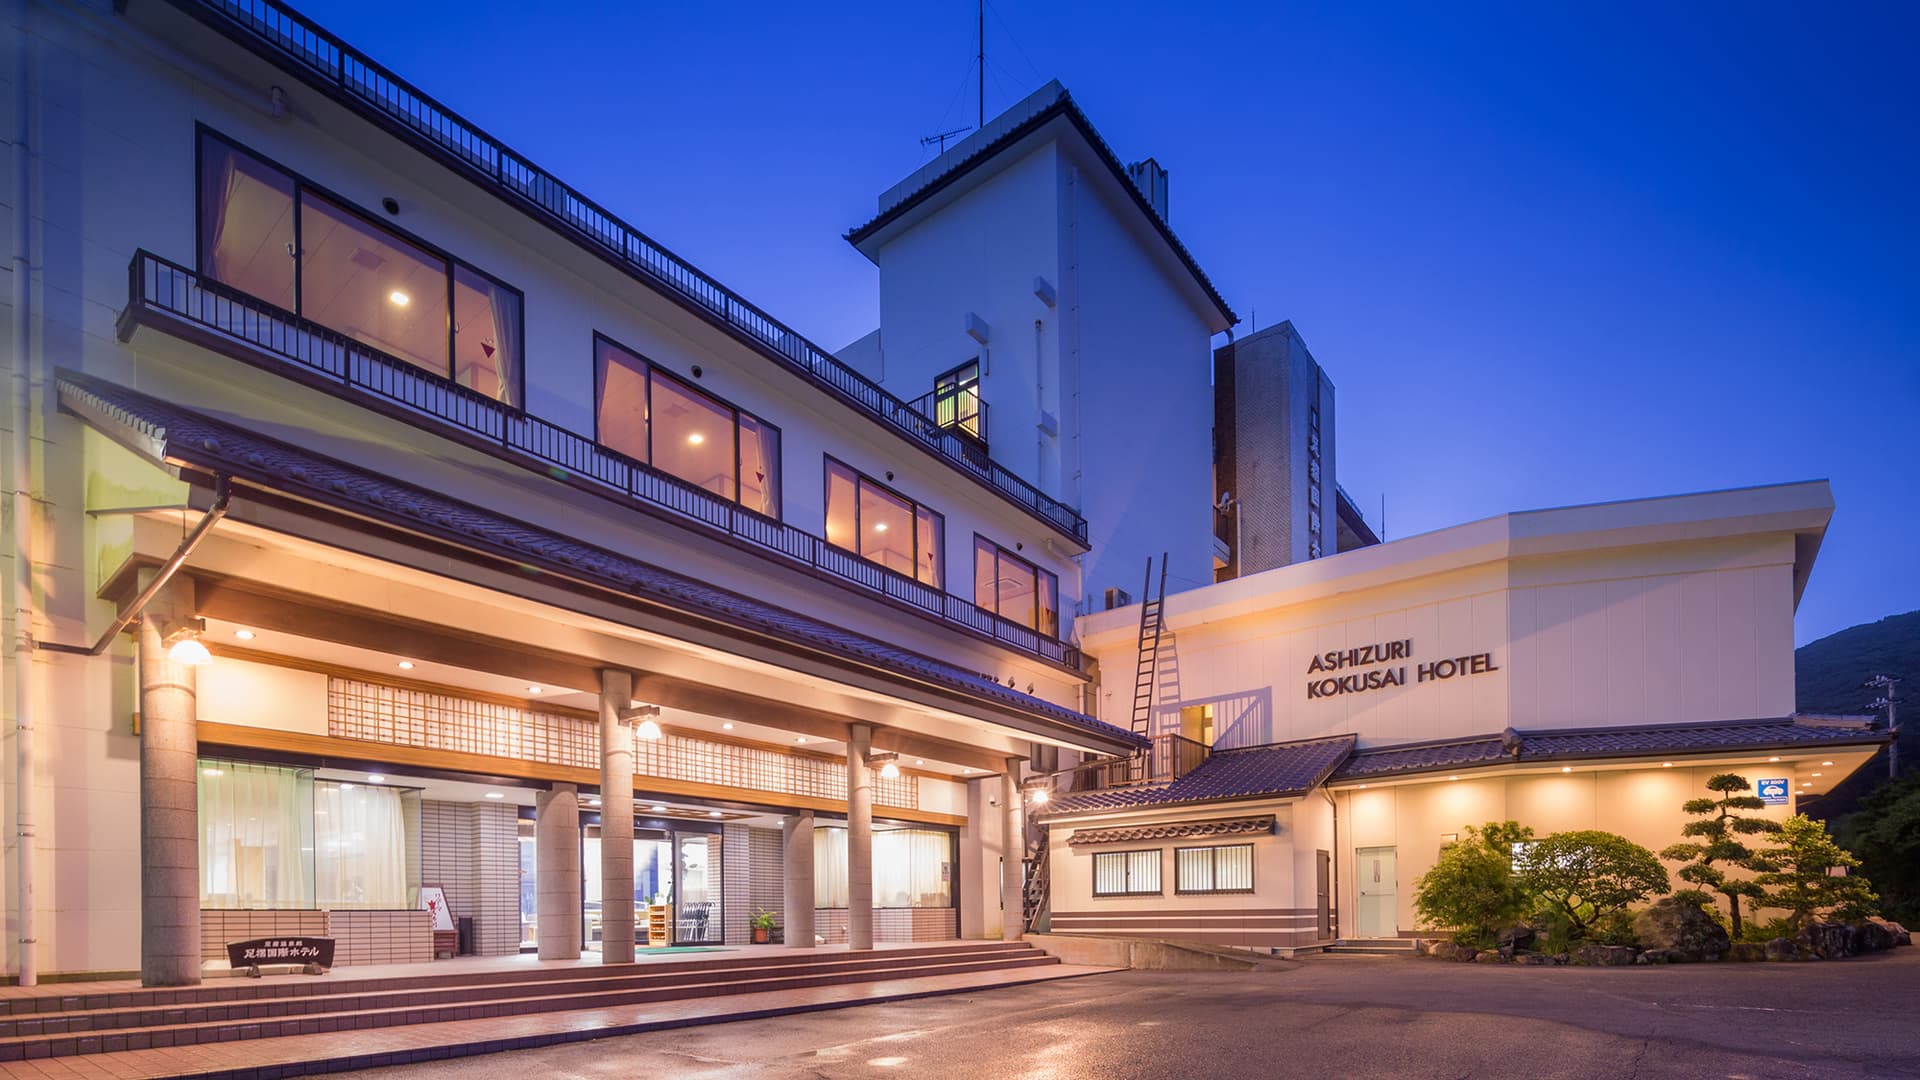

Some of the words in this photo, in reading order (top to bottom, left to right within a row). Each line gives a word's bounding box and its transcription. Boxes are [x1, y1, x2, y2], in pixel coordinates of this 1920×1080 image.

[1307, 639, 1411, 674] ASHIZURI
[1307, 667, 1405, 699] KOKUSAI
[1418, 653, 1499, 683] HOTEL
[243, 947, 320, 959] 足摺国際ホテル
